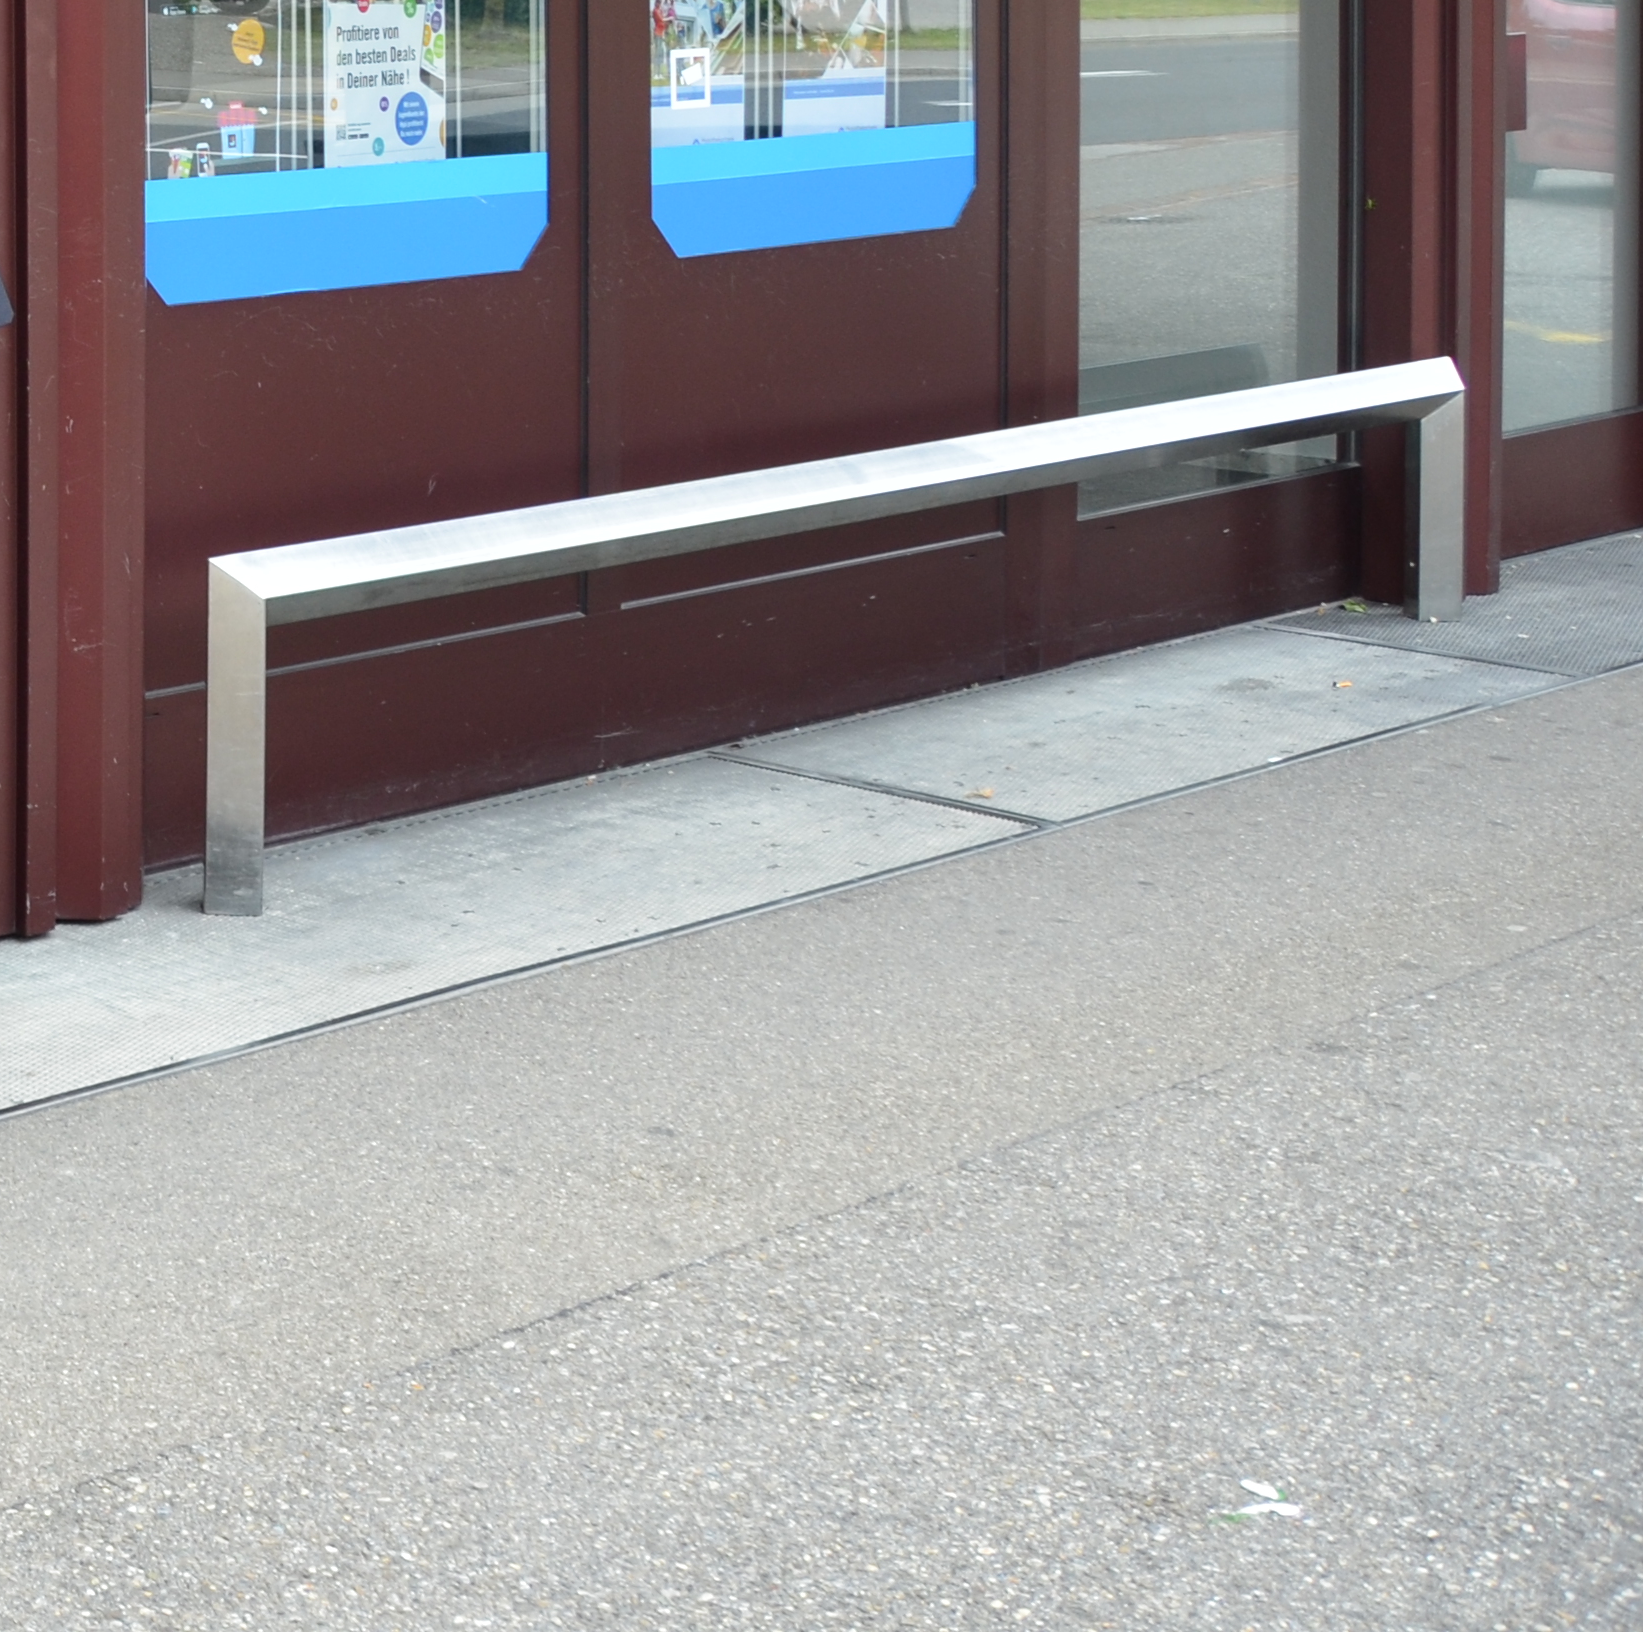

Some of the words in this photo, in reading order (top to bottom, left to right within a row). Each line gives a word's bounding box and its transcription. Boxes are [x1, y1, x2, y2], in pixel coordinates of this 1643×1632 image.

[336, 25, 380, 42] Profitiere
[382, 27, 399, 40] von
[336, 50, 353, 66] den
[355, 48, 388, 65] besten
[390, 45, 416, 63] Deals
[336, 73, 345, 89] in
[347, 71, 379, 89] Deiner
[381, 69, 405, 87] Nähe
